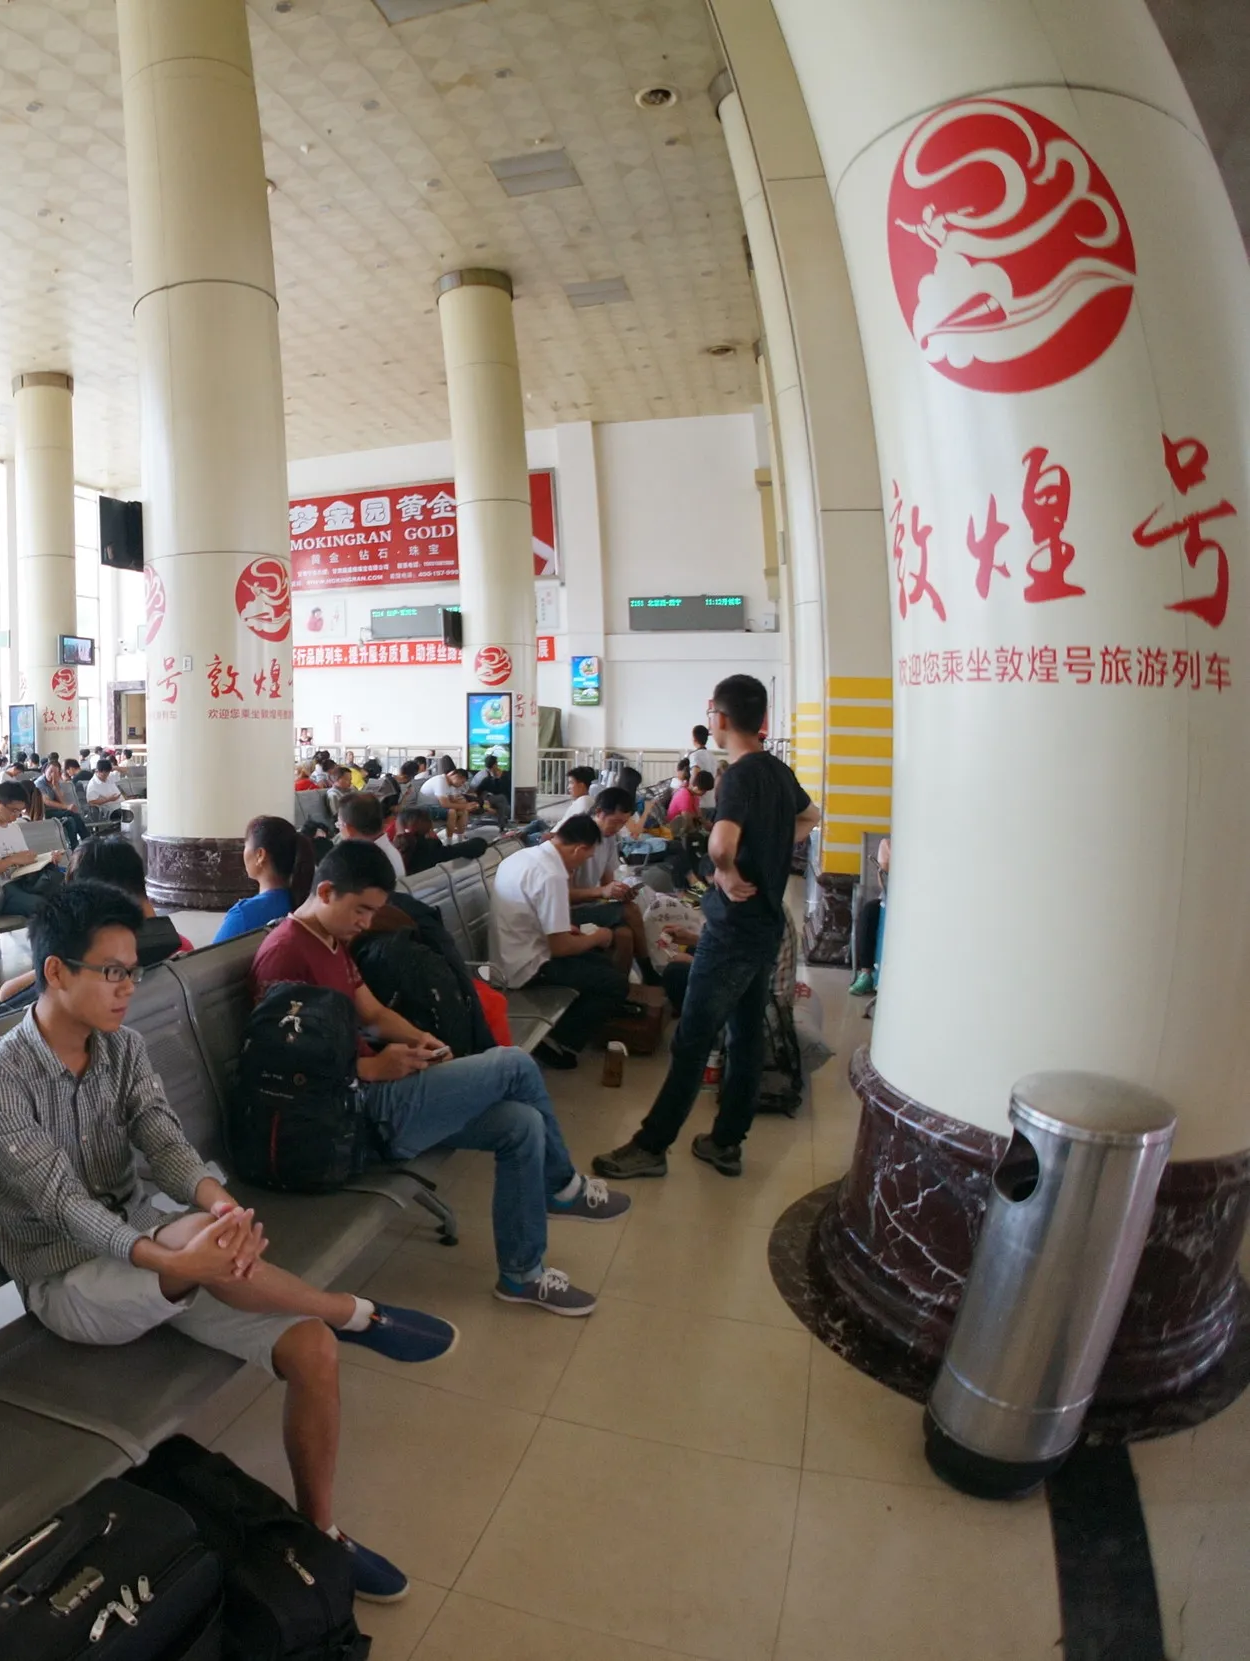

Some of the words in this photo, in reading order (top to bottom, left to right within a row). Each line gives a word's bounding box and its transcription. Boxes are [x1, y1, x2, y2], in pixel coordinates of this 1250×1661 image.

[290, 531, 392, 552] MOKINGRAN
[404, 524, 455, 541] GOLD
[891, 432, 1237, 628] 敦煌号
[206, 654, 293, 702] 敦煌
[899, 645, 1231, 692] 欢迎您乘坐敦煌号旅游列车
